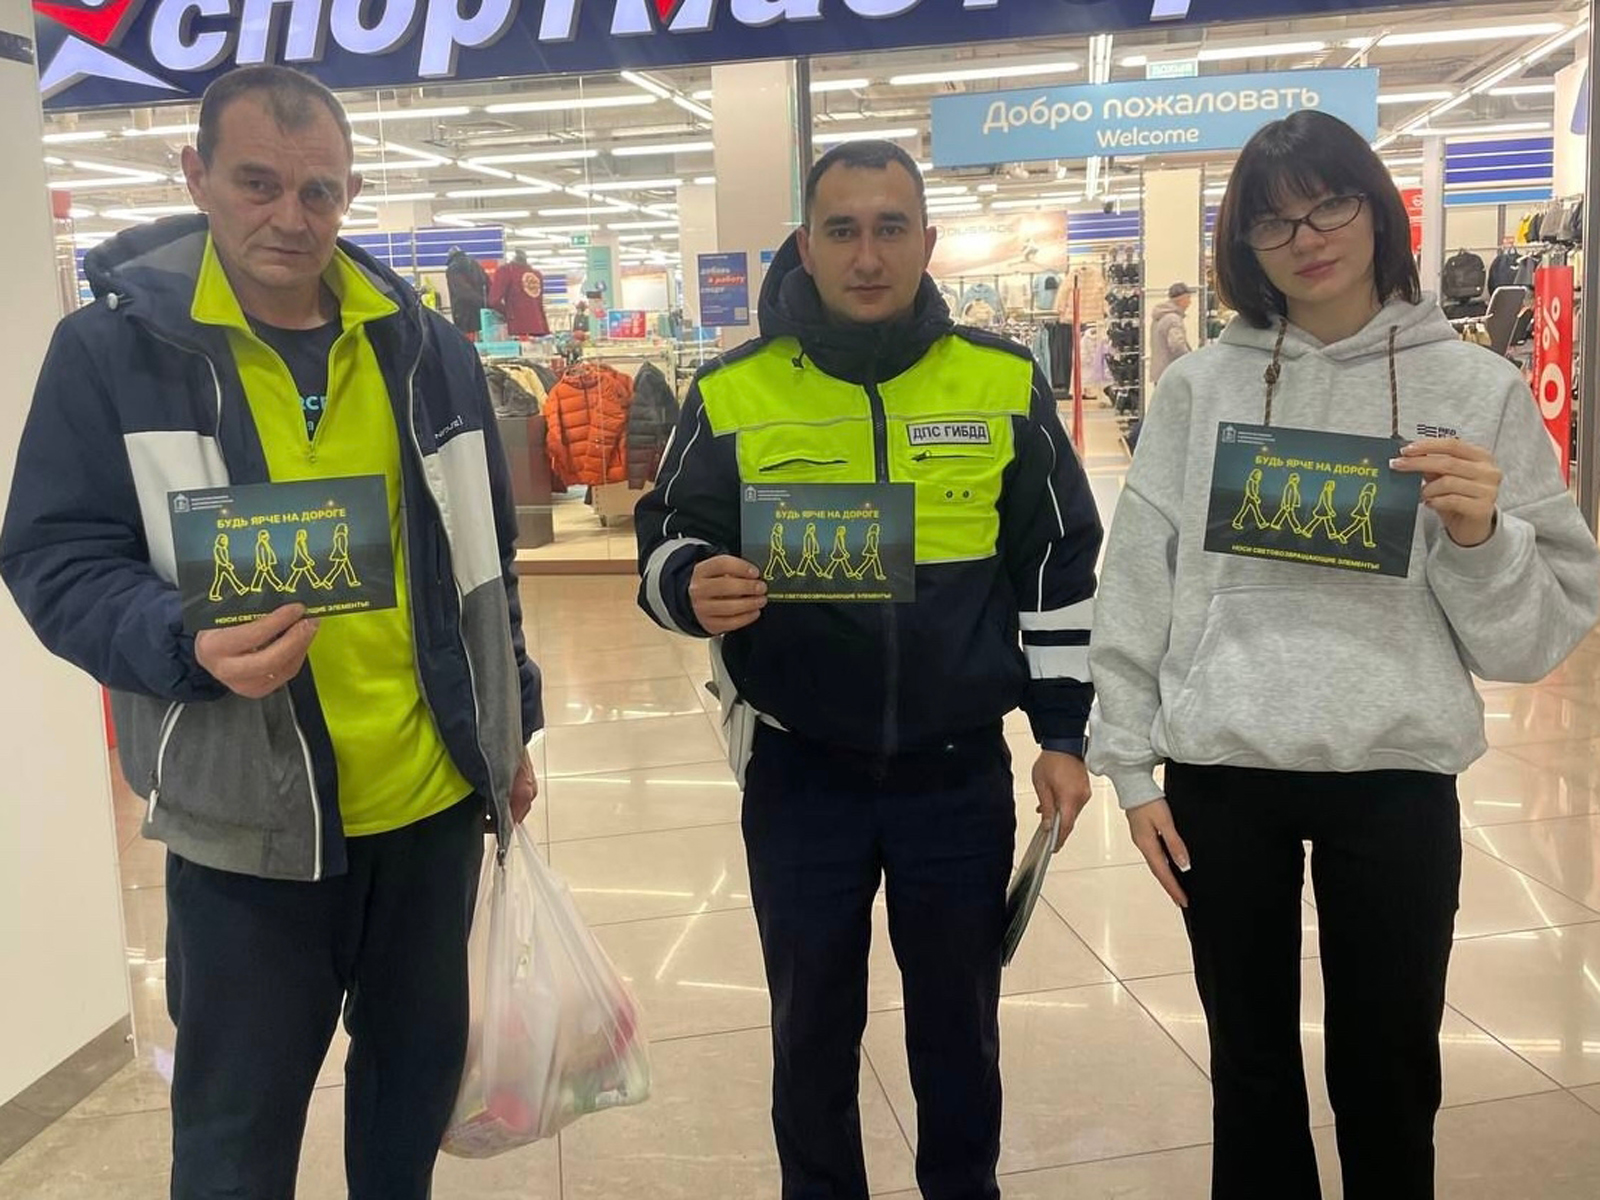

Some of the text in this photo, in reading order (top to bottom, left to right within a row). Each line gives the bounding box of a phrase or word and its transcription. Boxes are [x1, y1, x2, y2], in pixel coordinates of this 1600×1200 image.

[982, 86, 1320, 134] Добро пожаловать
[1097, 126, 1200, 148] Welcome
[913, 424, 987, 441] ДПС ГИБДД
[1256, 455, 1380, 478] БУДЬ ЯРЧЕ НА ДОРОГЕ
[217, 507, 347, 529] БУДЬ ЯРЧЕ НА ДОРОГЕ
[775, 509, 801, 520] БУДЬ
[827, 509, 841, 519] НА
[841, 509, 880, 521] ДОРОГЕ
